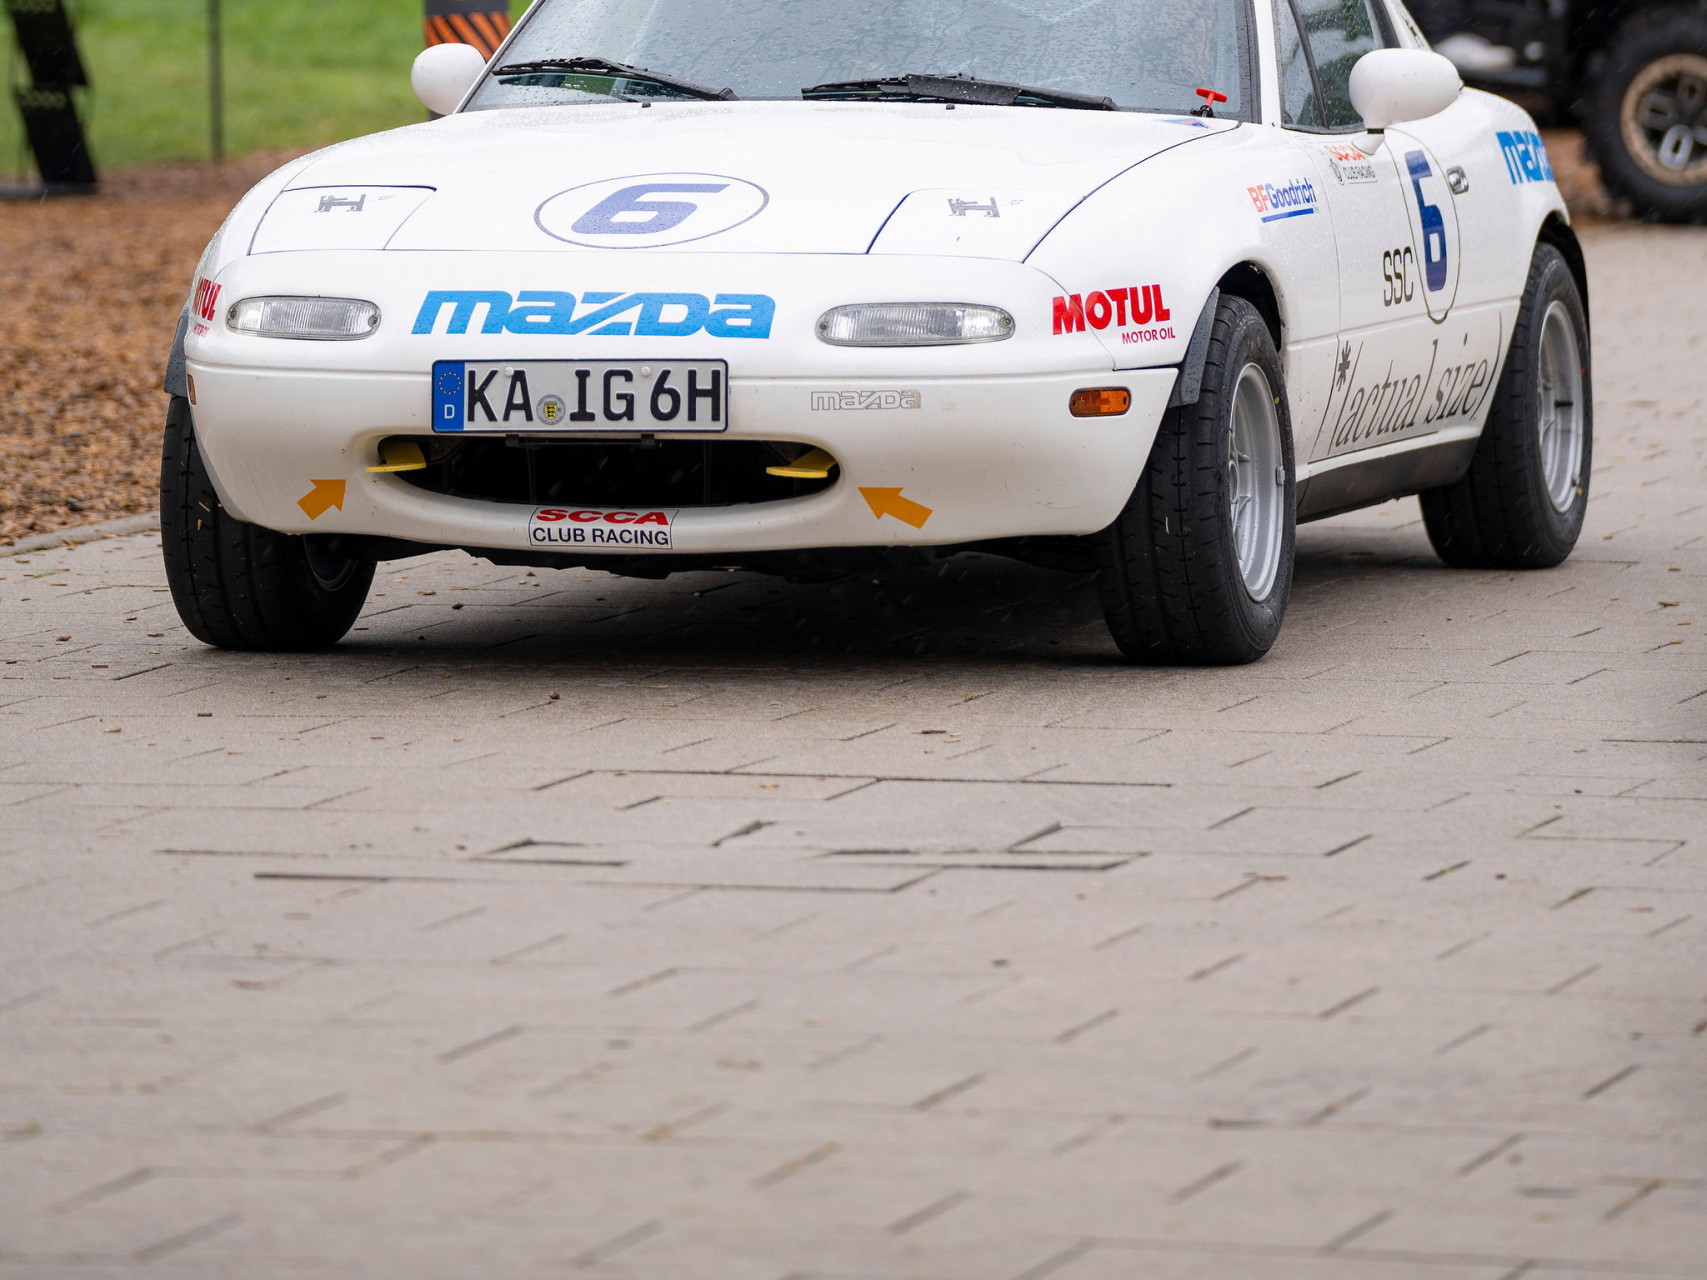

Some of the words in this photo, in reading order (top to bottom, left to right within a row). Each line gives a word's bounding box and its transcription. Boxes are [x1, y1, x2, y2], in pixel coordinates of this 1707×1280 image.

[570, 183, 731, 235] 6
[1246, 177, 1317, 213] BFGoodrich
[1404, 149, 1447, 292] 6
[1383, 246, 1414, 307] SSC
[1052, 284, 1171, 335] MOTUL
[1121, 328, 1159, 345] MOTOR
[1158, 326, 1176, 341] OIL
[444, 404, 455, 419] D
[467, 369, 534, 421] KA
[532, 527, 586, 543] CLUB
[592, 528, 669, 546] RACING
[536, 508, 669, 526] SCCA
